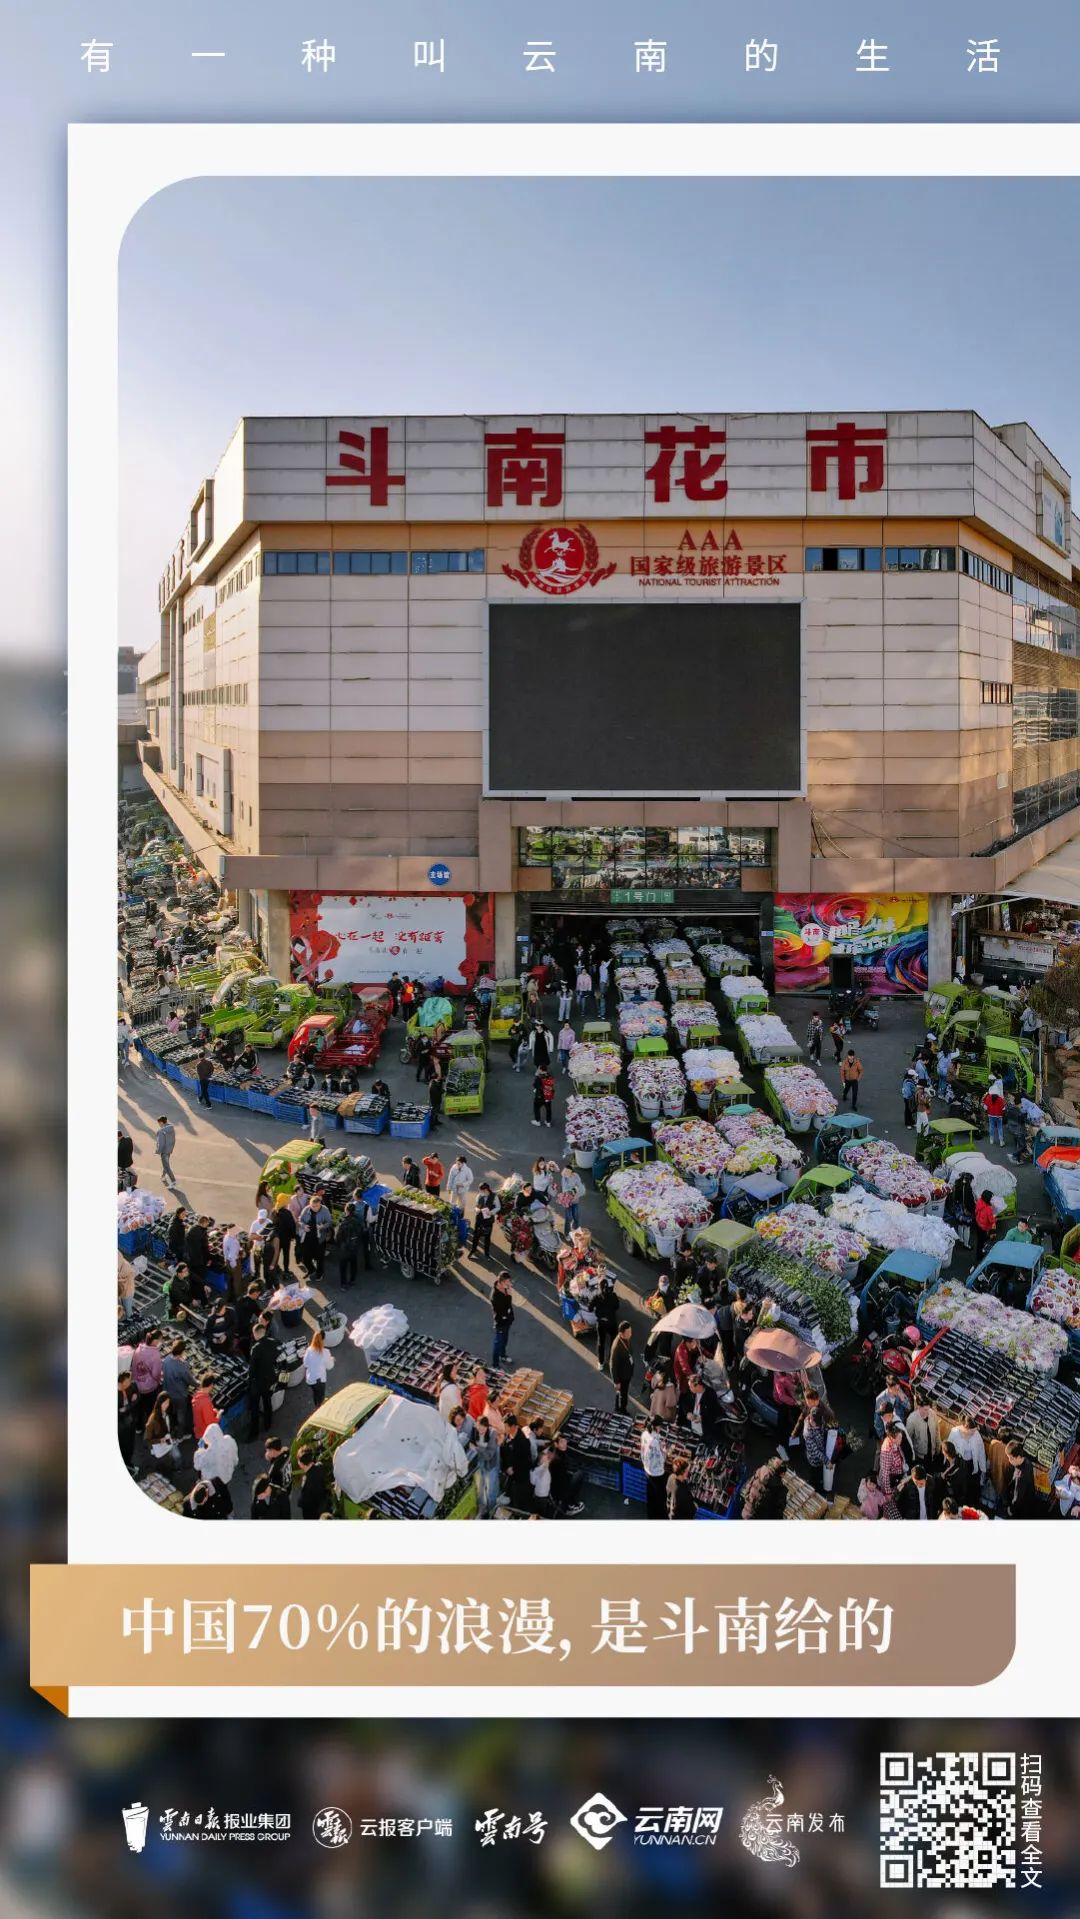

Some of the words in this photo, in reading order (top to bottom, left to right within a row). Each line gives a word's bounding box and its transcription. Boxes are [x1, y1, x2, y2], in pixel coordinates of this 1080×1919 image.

[326, 424, 887, 507] 斗南花市
[678, 528, 743, 551] AAA
[630, 555, 786, 576] 国家级旅游景区
[639, 578, 682, 587] NATIONAL
[685, 578, 722, 586] TOURIST
[724, 577, 780, 587] ATTRACTION
[624, 891, 657, 903] 1号门
